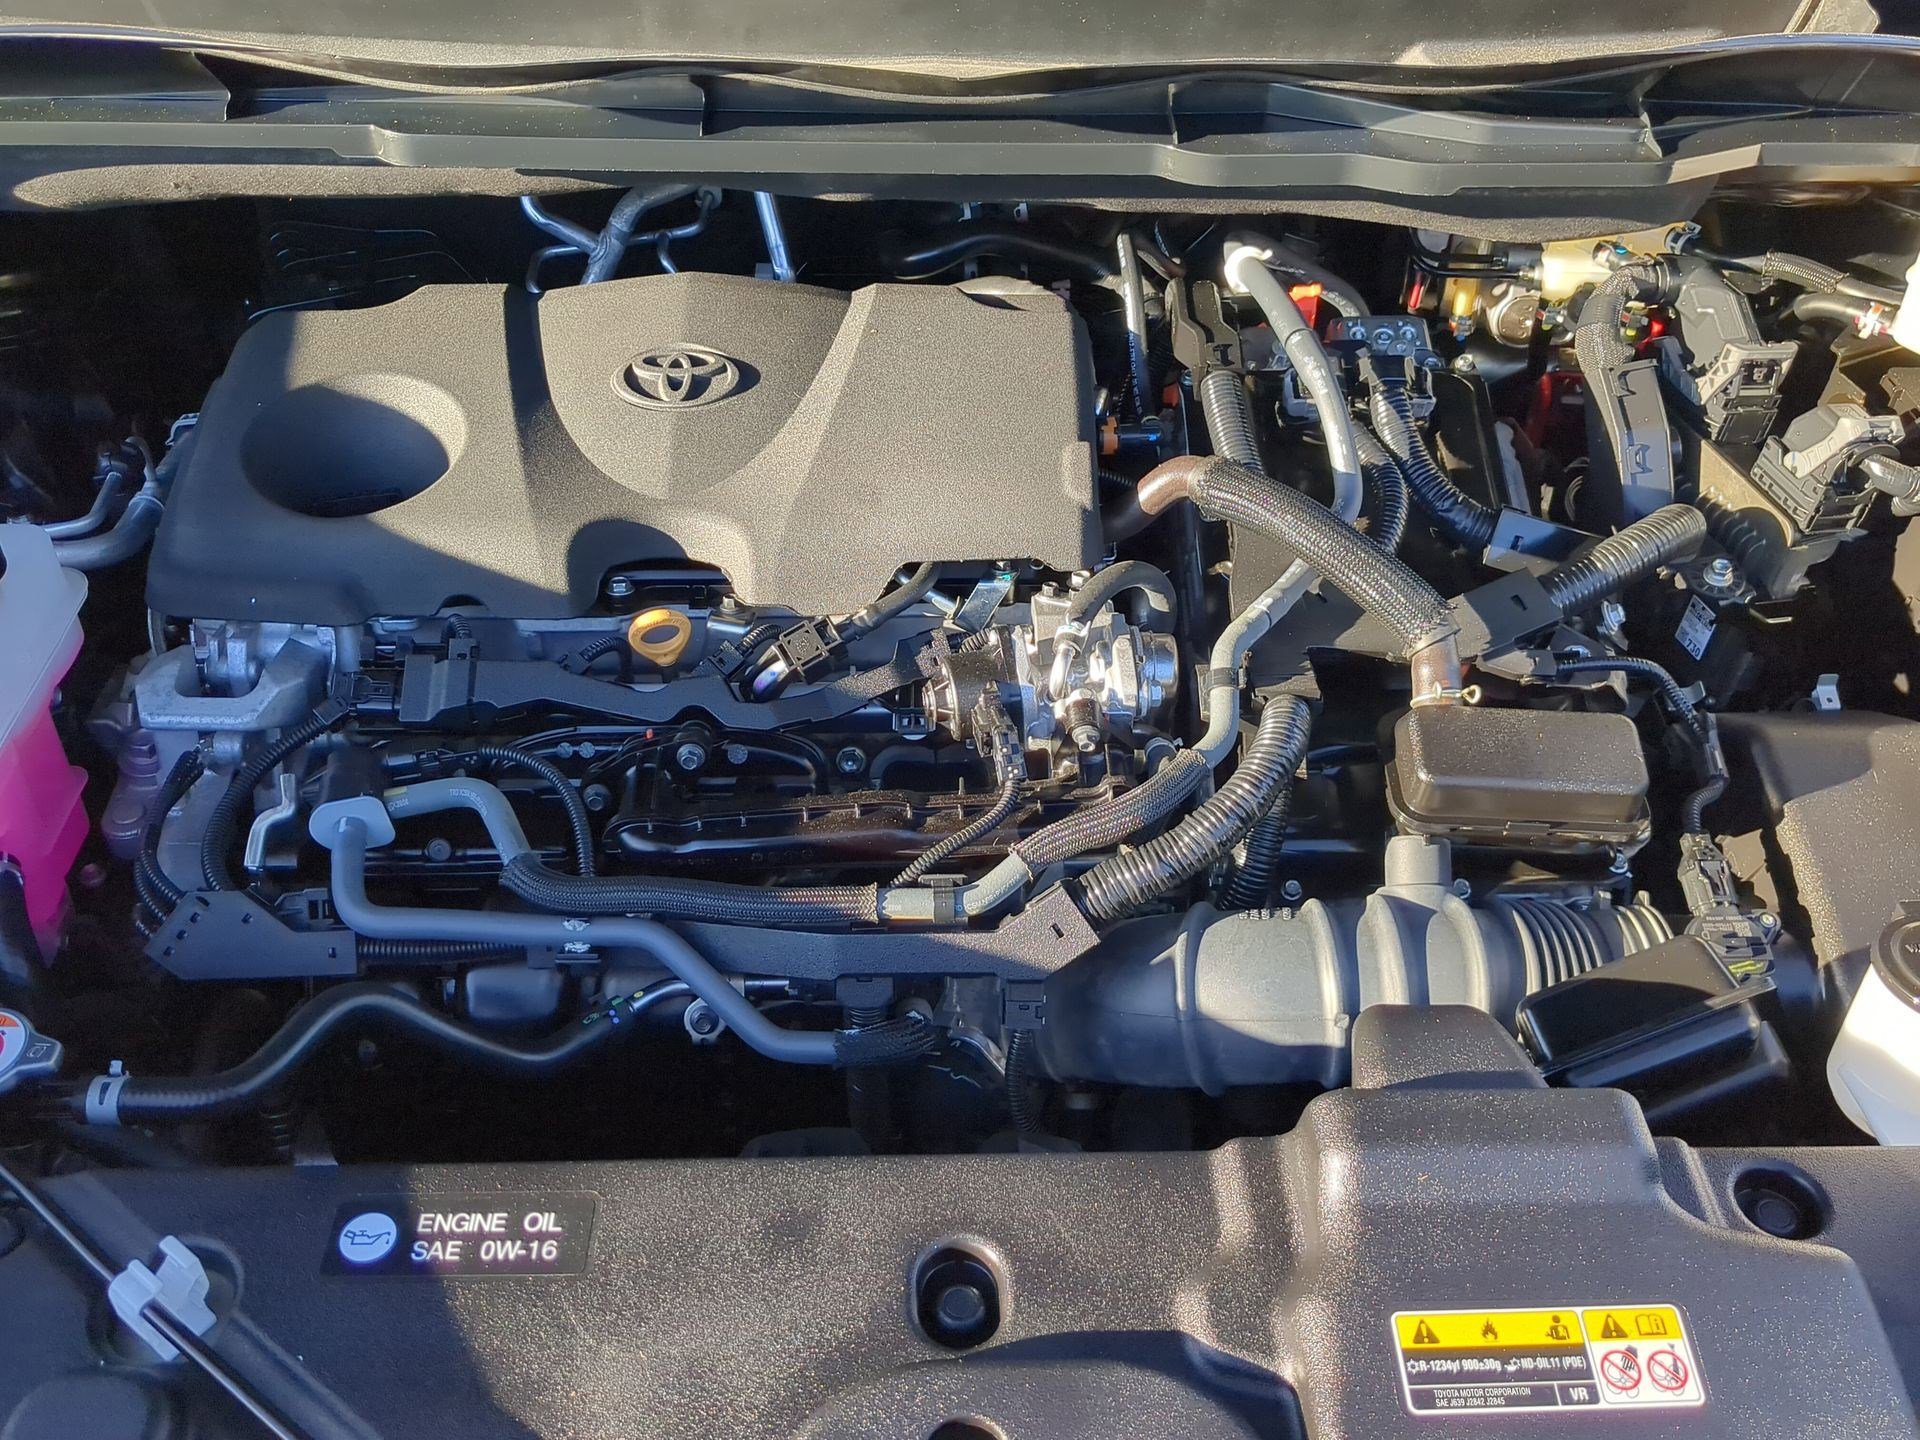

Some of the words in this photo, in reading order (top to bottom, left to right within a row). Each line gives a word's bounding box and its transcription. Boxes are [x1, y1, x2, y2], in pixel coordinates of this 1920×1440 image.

[417, 1213, 507, 1233] ENGINE
[523, 1213, 562, 1232] OIL
[411, 1241, 461, 1261] SAE
[480, 1240, 557, 1261] 0W-16
[1562, 1355, 1587, 1370] (POE)
[1433, 1389, 1460, 1398] TOYOTA
[1460, 1388, 1485, 1397] MOTOR
[1485, 1387, 1531, 1396] CORPORATION
[1569, 1387, 1589, 1401] VR
[1435, 1398, 1449, 1407] SAE
[1450, 1397, 1465, 1407] J639
